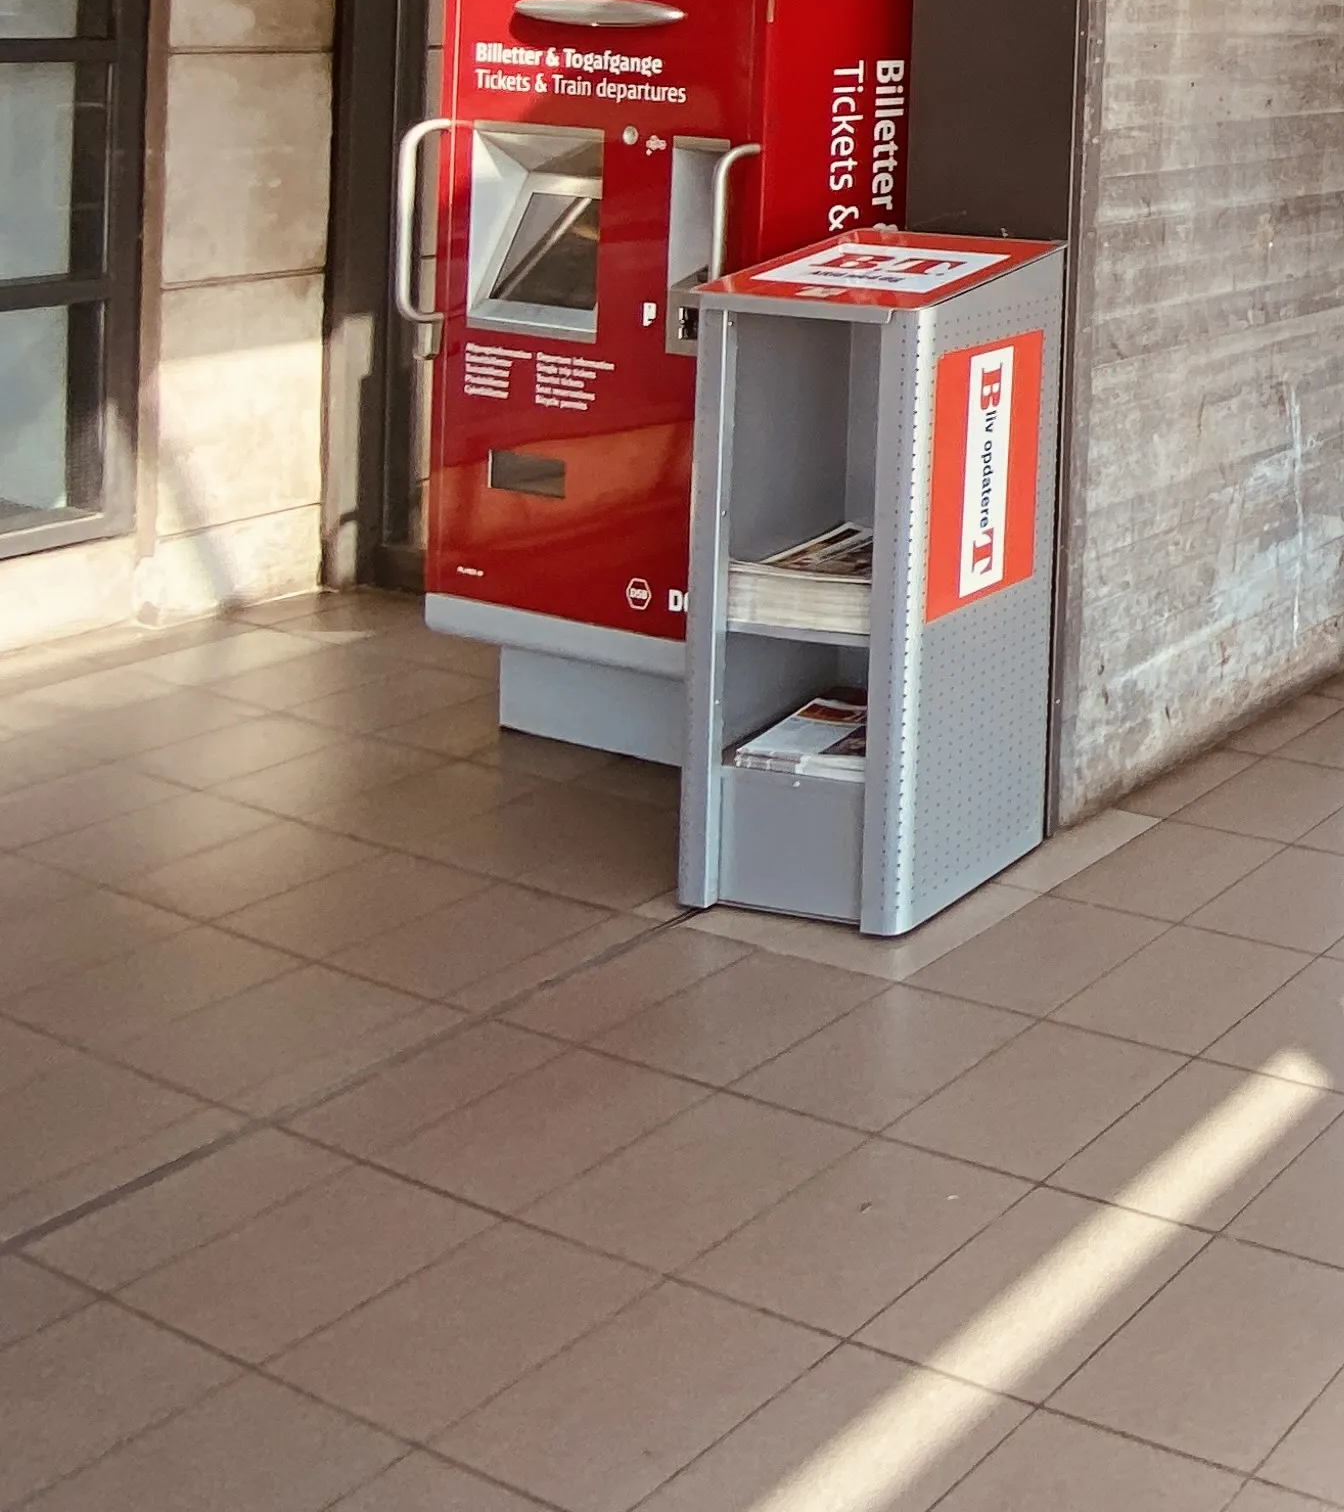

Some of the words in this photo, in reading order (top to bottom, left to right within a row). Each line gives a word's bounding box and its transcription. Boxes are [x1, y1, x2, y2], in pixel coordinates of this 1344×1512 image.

[475, 42, 543, 66] Billetter
[546, 50, 560, 67] &
[563, 49, 663, 75] Togafgange
[475, 69, 531, 92] Tickets
[534, 75, 547, 93] &
[552, 74, 591, 97] Train
[596, 78, 687, 104] departures
[828, 60, 864, 191] Tickets
[872, 60, 905, 210] Billetter
[828, 205, 859, 232] &
[980, 362, 1003, 433] Bliv
